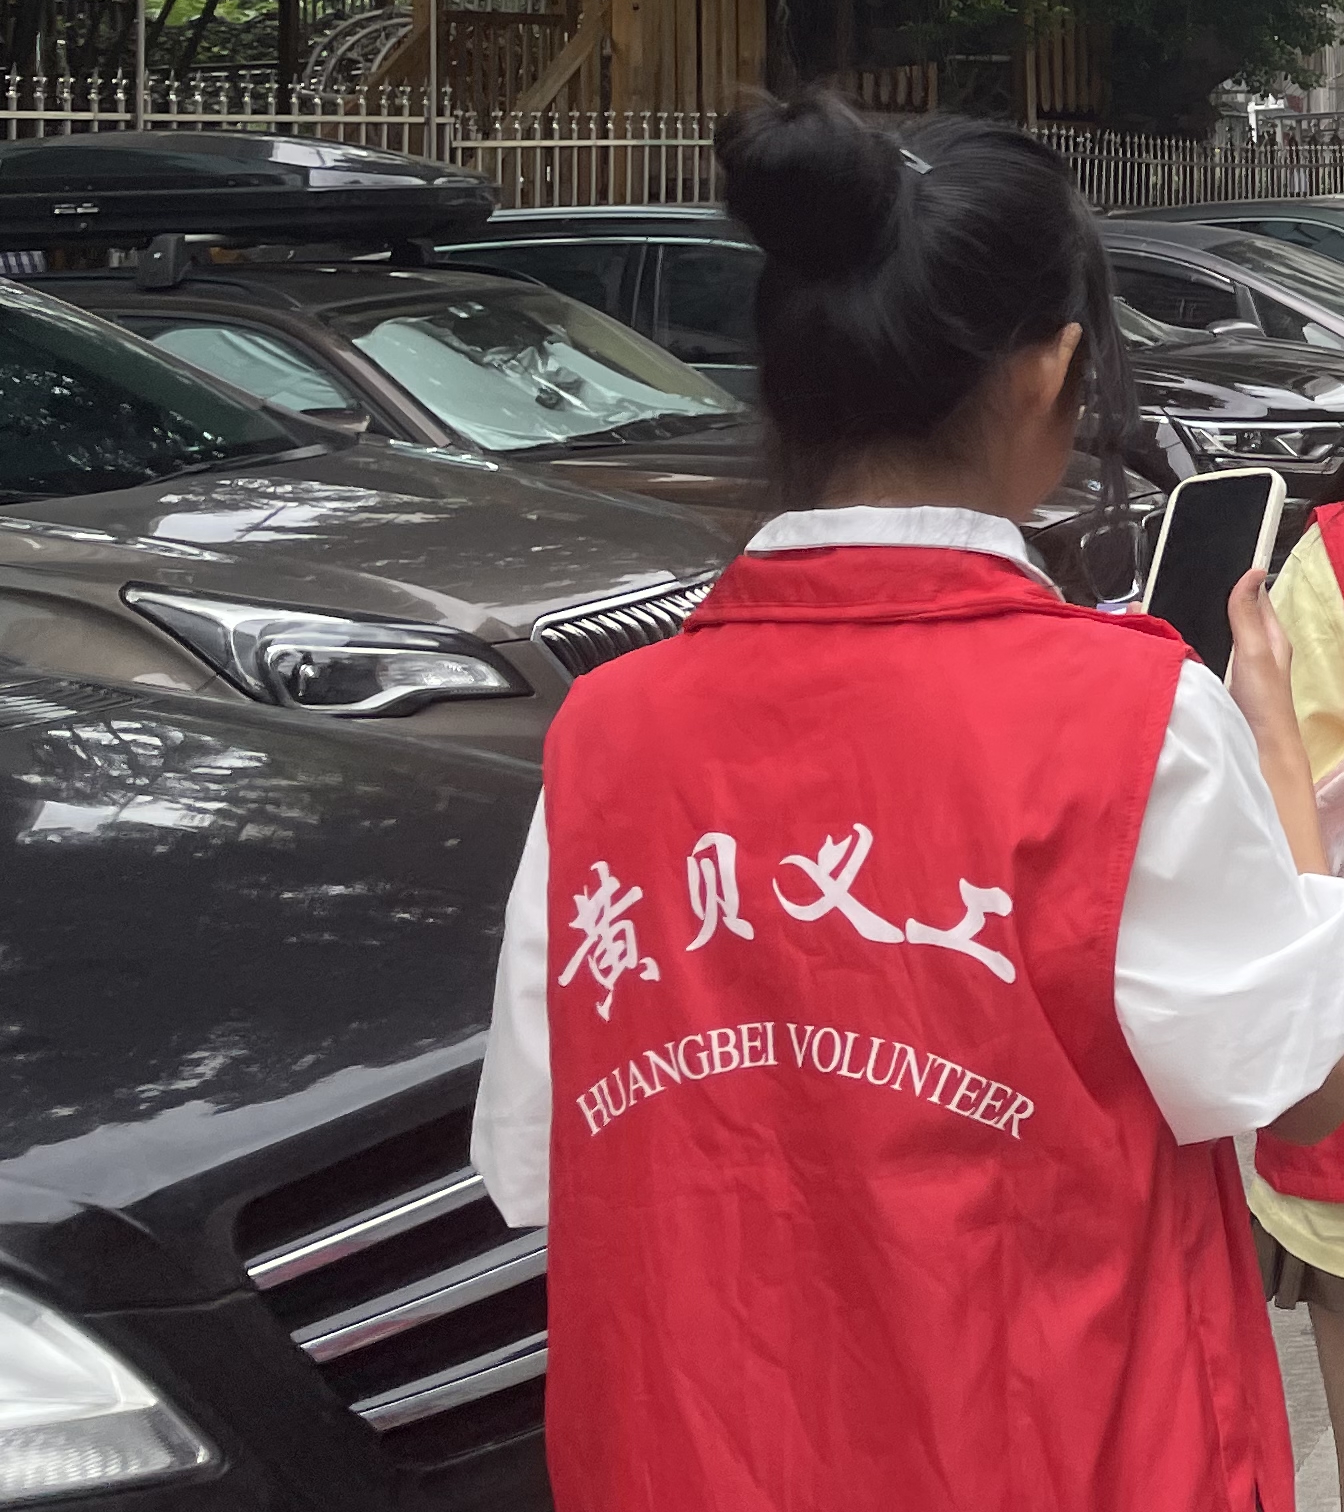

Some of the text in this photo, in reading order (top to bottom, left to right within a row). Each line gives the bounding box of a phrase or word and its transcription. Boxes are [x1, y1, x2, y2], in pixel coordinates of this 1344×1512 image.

[557, 822, 1017, 1022] 黄贝义工
[576, 1021, 1036, 1140] HUANGBEI VOLUNTEER
